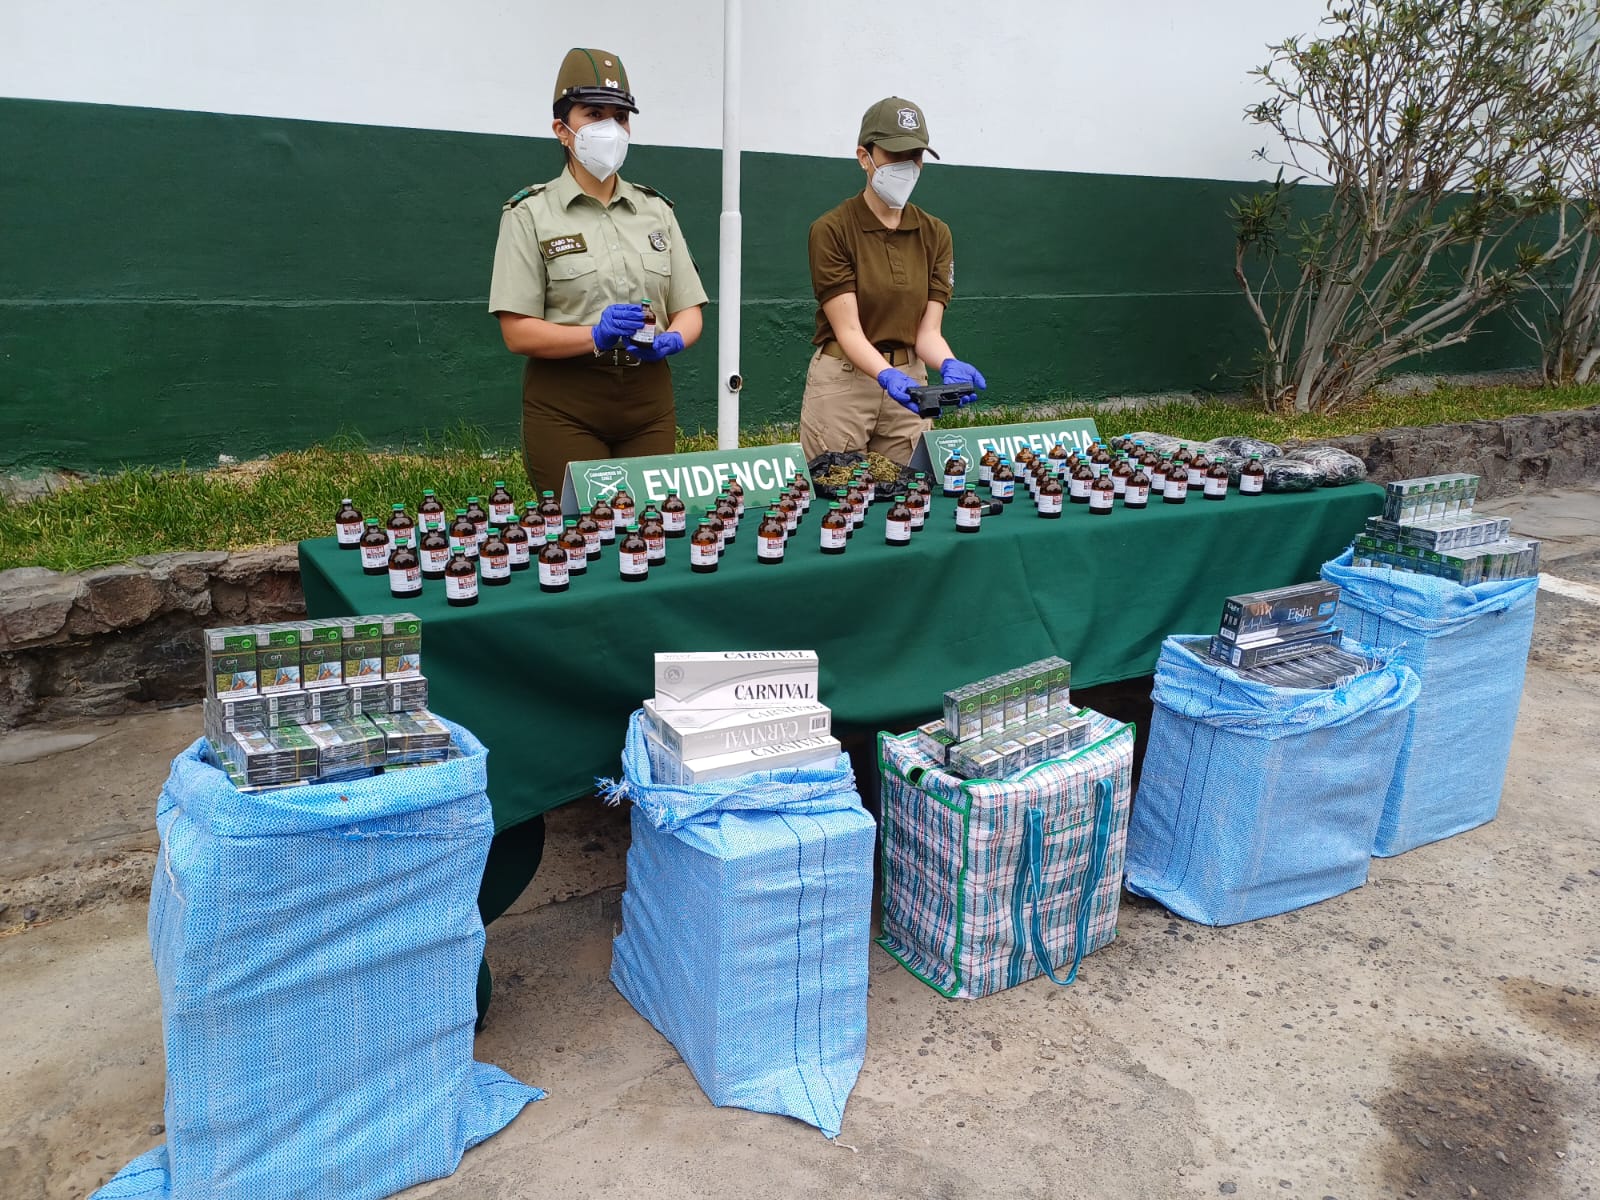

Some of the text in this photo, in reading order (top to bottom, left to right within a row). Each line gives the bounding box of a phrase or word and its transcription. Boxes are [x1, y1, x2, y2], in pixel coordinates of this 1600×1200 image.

[642, 456, 800, 501] EVIDENCIA
[1287, 604, 1314, 622] Eight
[724, 651, 810, 660] CARNIVAL
[734, 683, 814, 701] CARNIVAL
